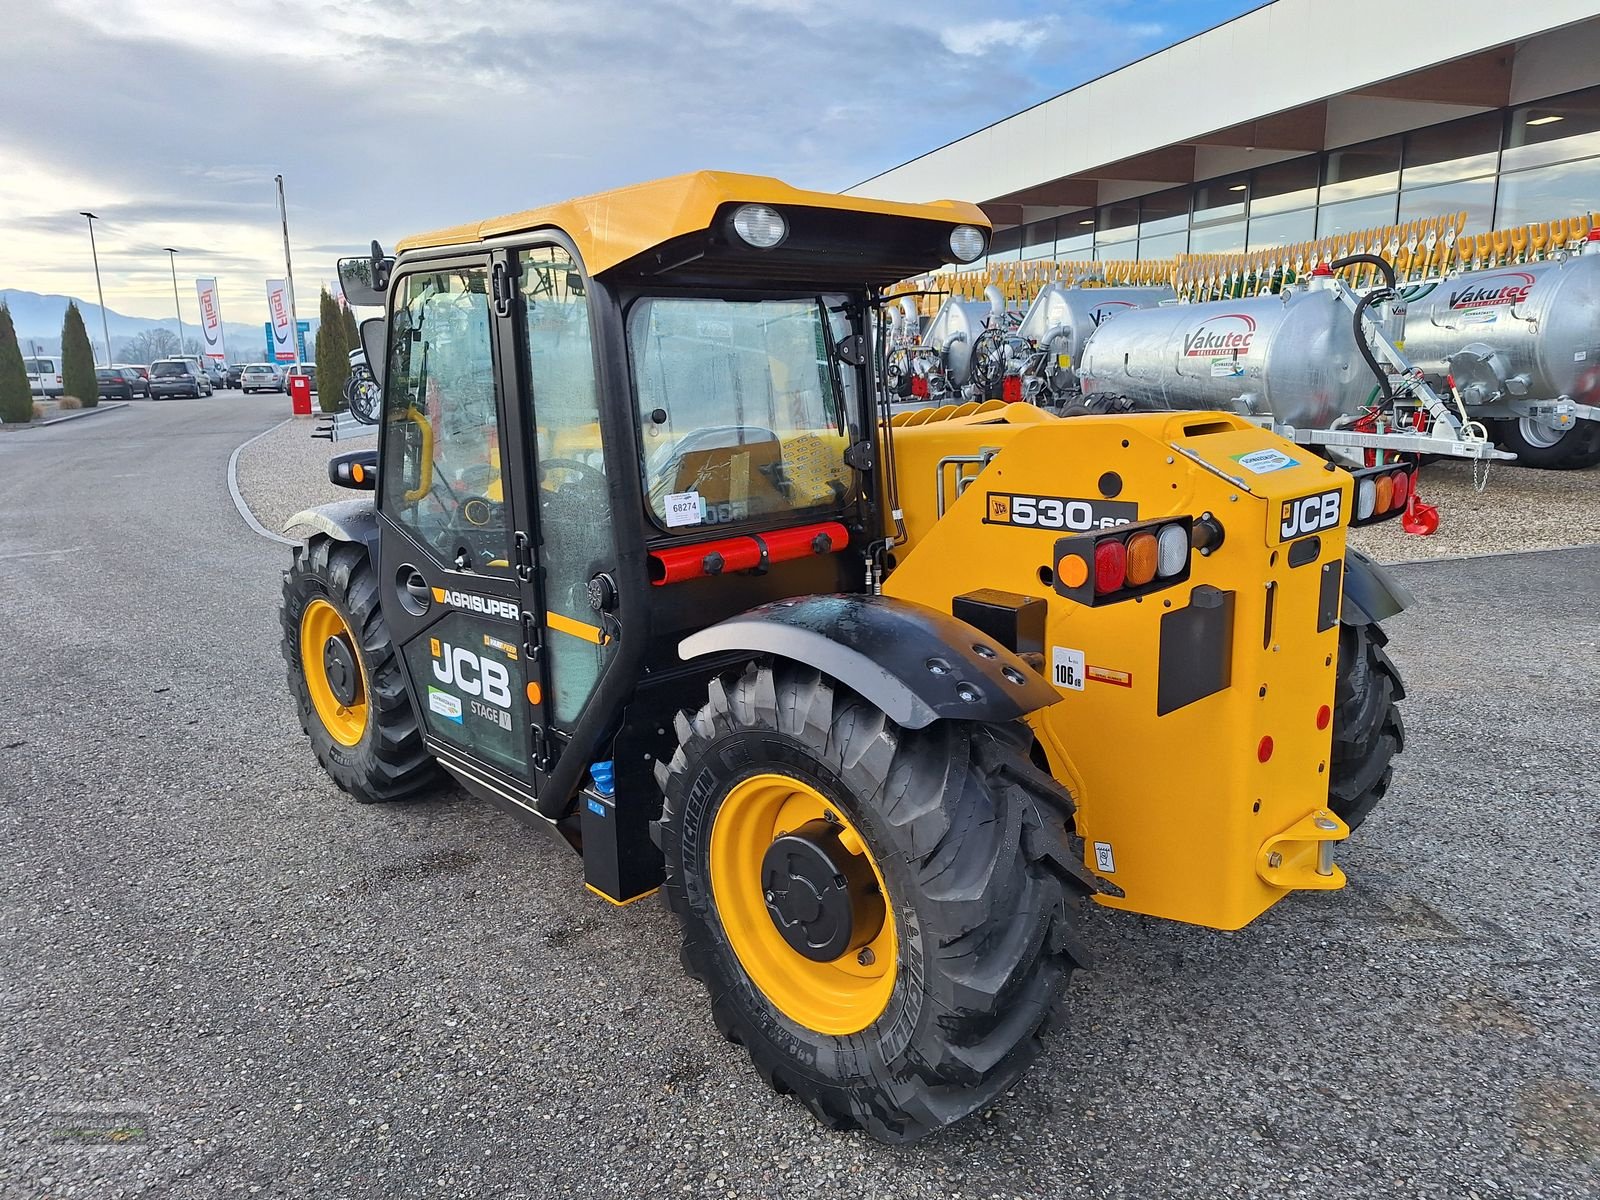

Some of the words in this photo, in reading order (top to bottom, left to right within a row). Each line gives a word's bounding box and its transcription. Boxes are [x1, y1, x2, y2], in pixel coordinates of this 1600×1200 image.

[1449, 285, 1533, 310] Vakutec
[1184, 327, 1253, 357] Vakutec
[672, 502, 697, 513] 68274
[1281, 492, 1340, 537] JCB
[444, 590, 519, 620] AGRISUPER
[432, 643, 512, 708] JCB
[1056, 664, 1073, 685] 106
[471, 701, 499, 723] STAGE
[683, 768, 714, 874] MICHELIN
[879, 943, 924, 1066] MICHELIN
